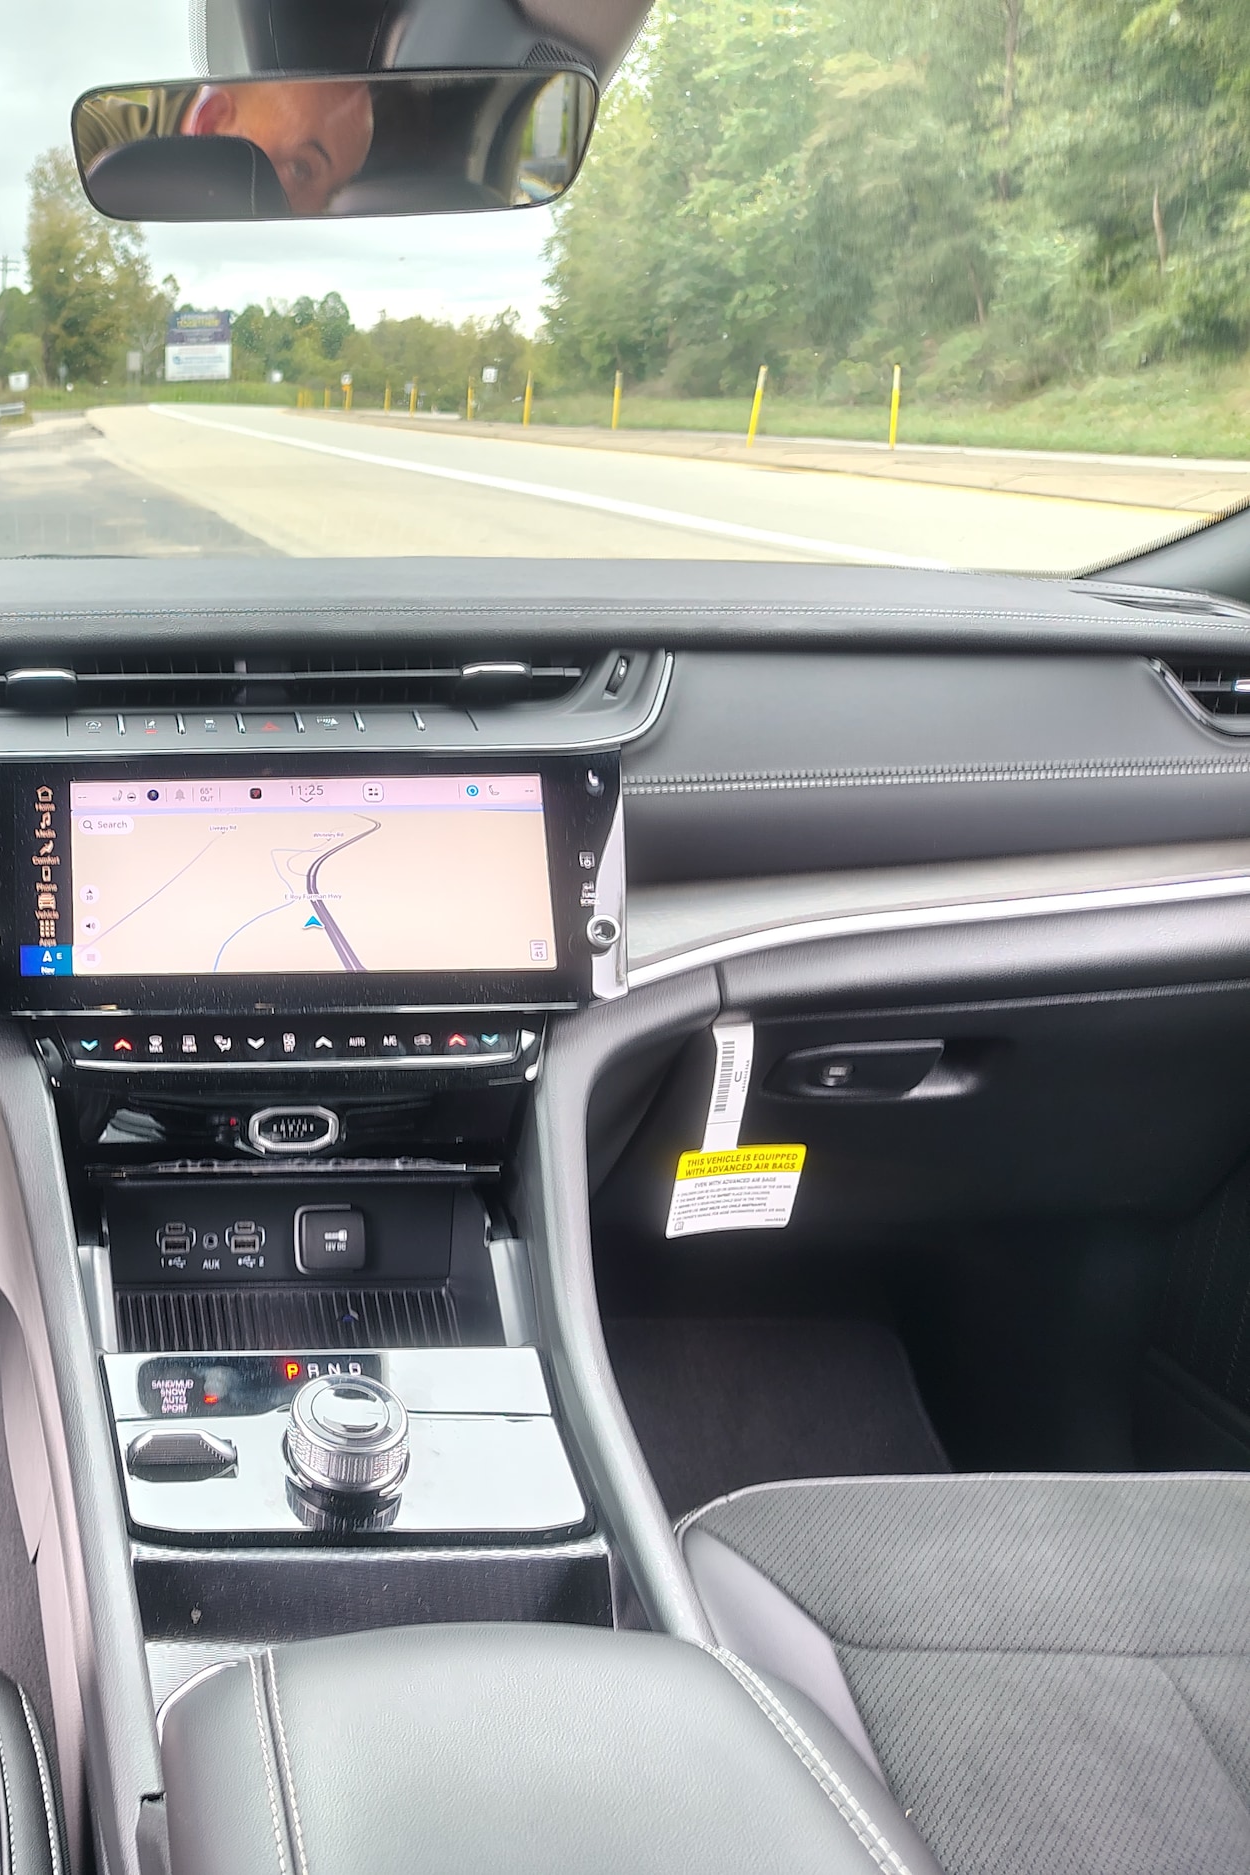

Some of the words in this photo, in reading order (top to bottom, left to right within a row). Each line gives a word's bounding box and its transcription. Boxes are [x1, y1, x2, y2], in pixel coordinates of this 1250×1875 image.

[289, 785, 324, 796] 11:25
[34, 803, 56, 812] Home
[97, 820, 128, 830] Search
[34, 829, 57, 839] Media
[32, 856, 60, 866] Comfort
[35, 882, 58, 892] Phone
[290, 893, 302, 901] Roy
[327, 893, 342, 901] Hwy
[34, 910, 59, 920] Vehicle
[38, 938, 57, 947] Apps
[40, 966, 55, 975] Nav
[350, 1036, 366, 1047] AUTO
[383, 1035, 397, 1046] A/C
[687, 1158, 705, 1168] THIS
[706, 1154, 740, 1166] VEHICLE
[742, 1154, 751, 1162] IS
[753, 1152, 798, 1162] EQUIPPED
[685, 1167, 706, 1177] WITH
[706, 1163, 753, 1175] ADVANCED
[754, 1162, 770, 1171] AIR
[771, 1161, 796, 1171] BAGS
[202, 1259, 221, 1270] AUX
[286, 1363, 299, 1380] P
[307, 1363, 320, 1378] R
[328, 1362, 341, 1375] N
[151, 1379, 194, 1390] SAND/MUD
[160, 1388, 187, 1397] SNOW
[163, 1396, 187, 1404] AUTO
[161, 1404, 188, 1413] SPORT
